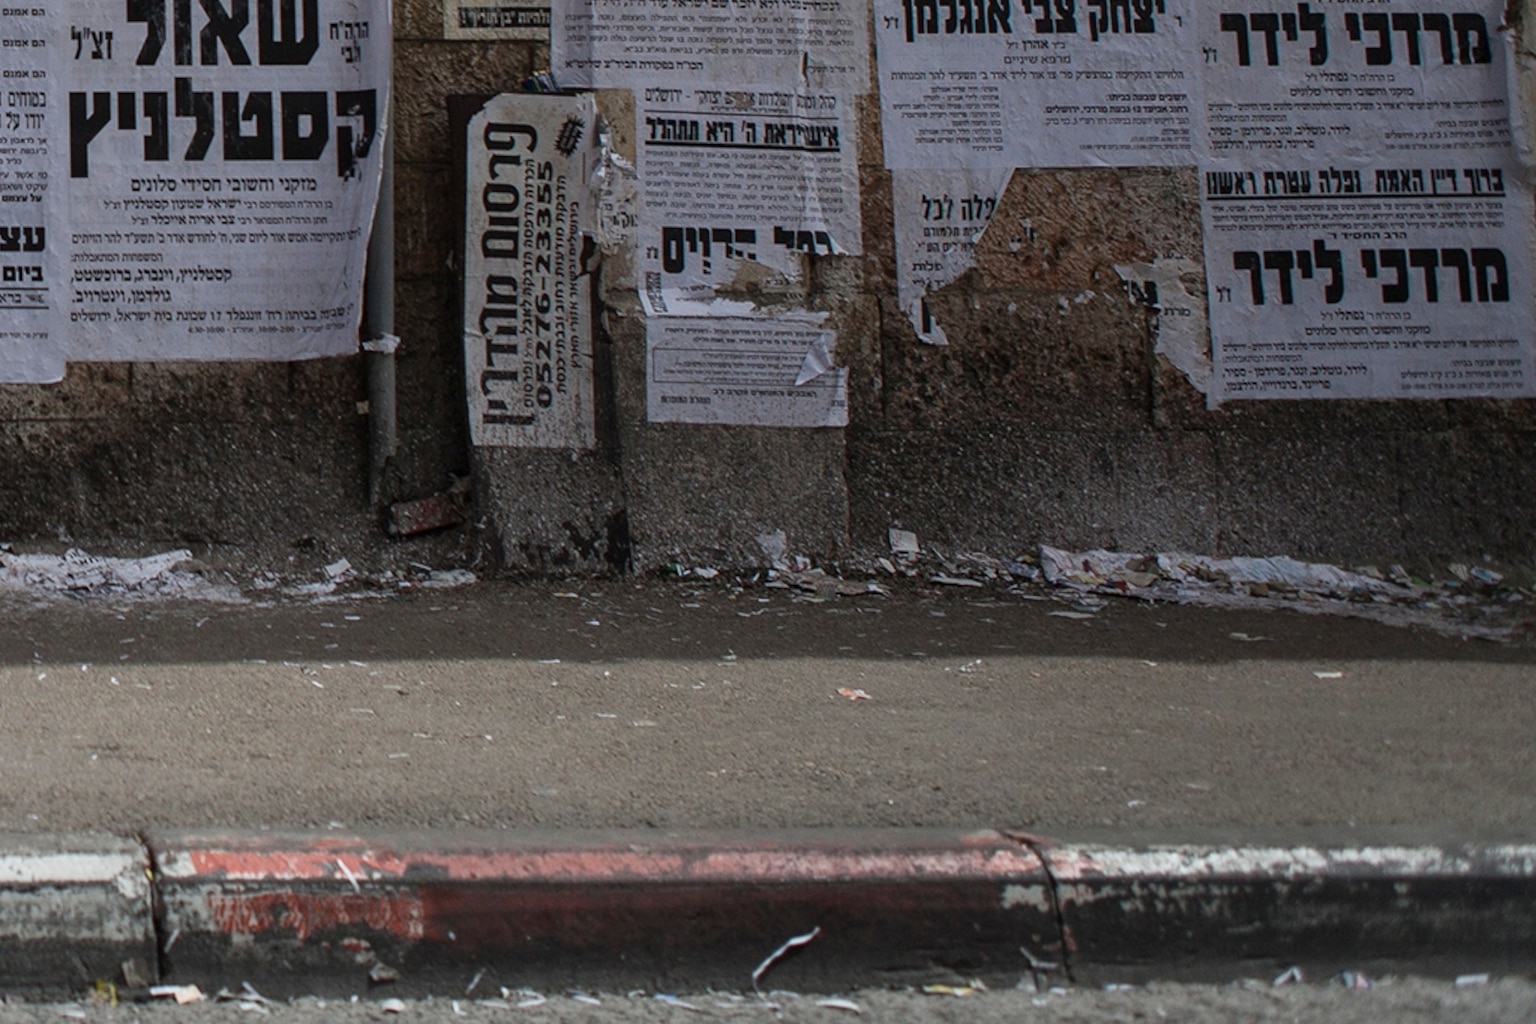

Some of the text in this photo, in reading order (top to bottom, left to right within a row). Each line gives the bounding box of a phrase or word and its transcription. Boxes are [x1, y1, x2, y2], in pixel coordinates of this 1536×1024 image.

[71, 26, 114, 60] זצ"ל
[1219, 2, 1330, 67] לידר
[1344, 12, 1493, 65] מרדכי
[68, 76, 377, 178] קסטלניץ
[645, 116, 699, 141] תתהלל
[706, 120, 734, 142] היא
[130, 173, 317, 195] מזקני וחשובי חסידי סלונים
[481, 121, 536, 260] פרסום
[1263, 170, 1311, 196] עטרת
[1318, 167, 1362, 195] נפלה
[1375, 169, 1424, 195] האמת
[1430, 169, 1457, 195] דיין
[1463, 168, 1504, 195] ברוך
[3, 264, 44, 282] ביום
[535, 161, 553, 409] 05276-23355
[1232, 239, 1345, 306] לידר
[1360, 247, 1511, 303] מרדכי
[478, 274, 534, 426] מהדרין
